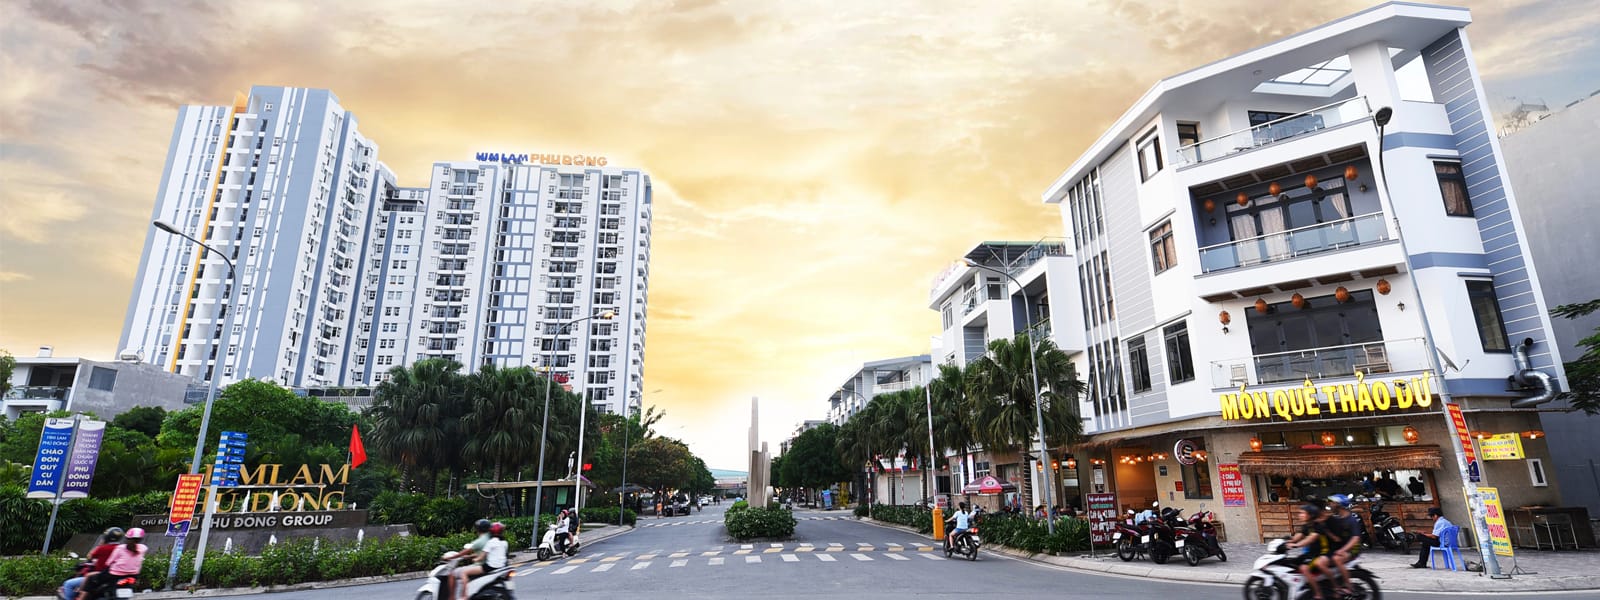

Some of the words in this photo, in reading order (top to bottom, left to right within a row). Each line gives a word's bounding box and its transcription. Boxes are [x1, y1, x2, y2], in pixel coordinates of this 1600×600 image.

[1221, 383, 1270, 420] MÓN
[1273, 378, 1320, 422] QUÊ
[1322, 371, 1391, 414] THẢO
[282, 515, 333, 526] GROUP
